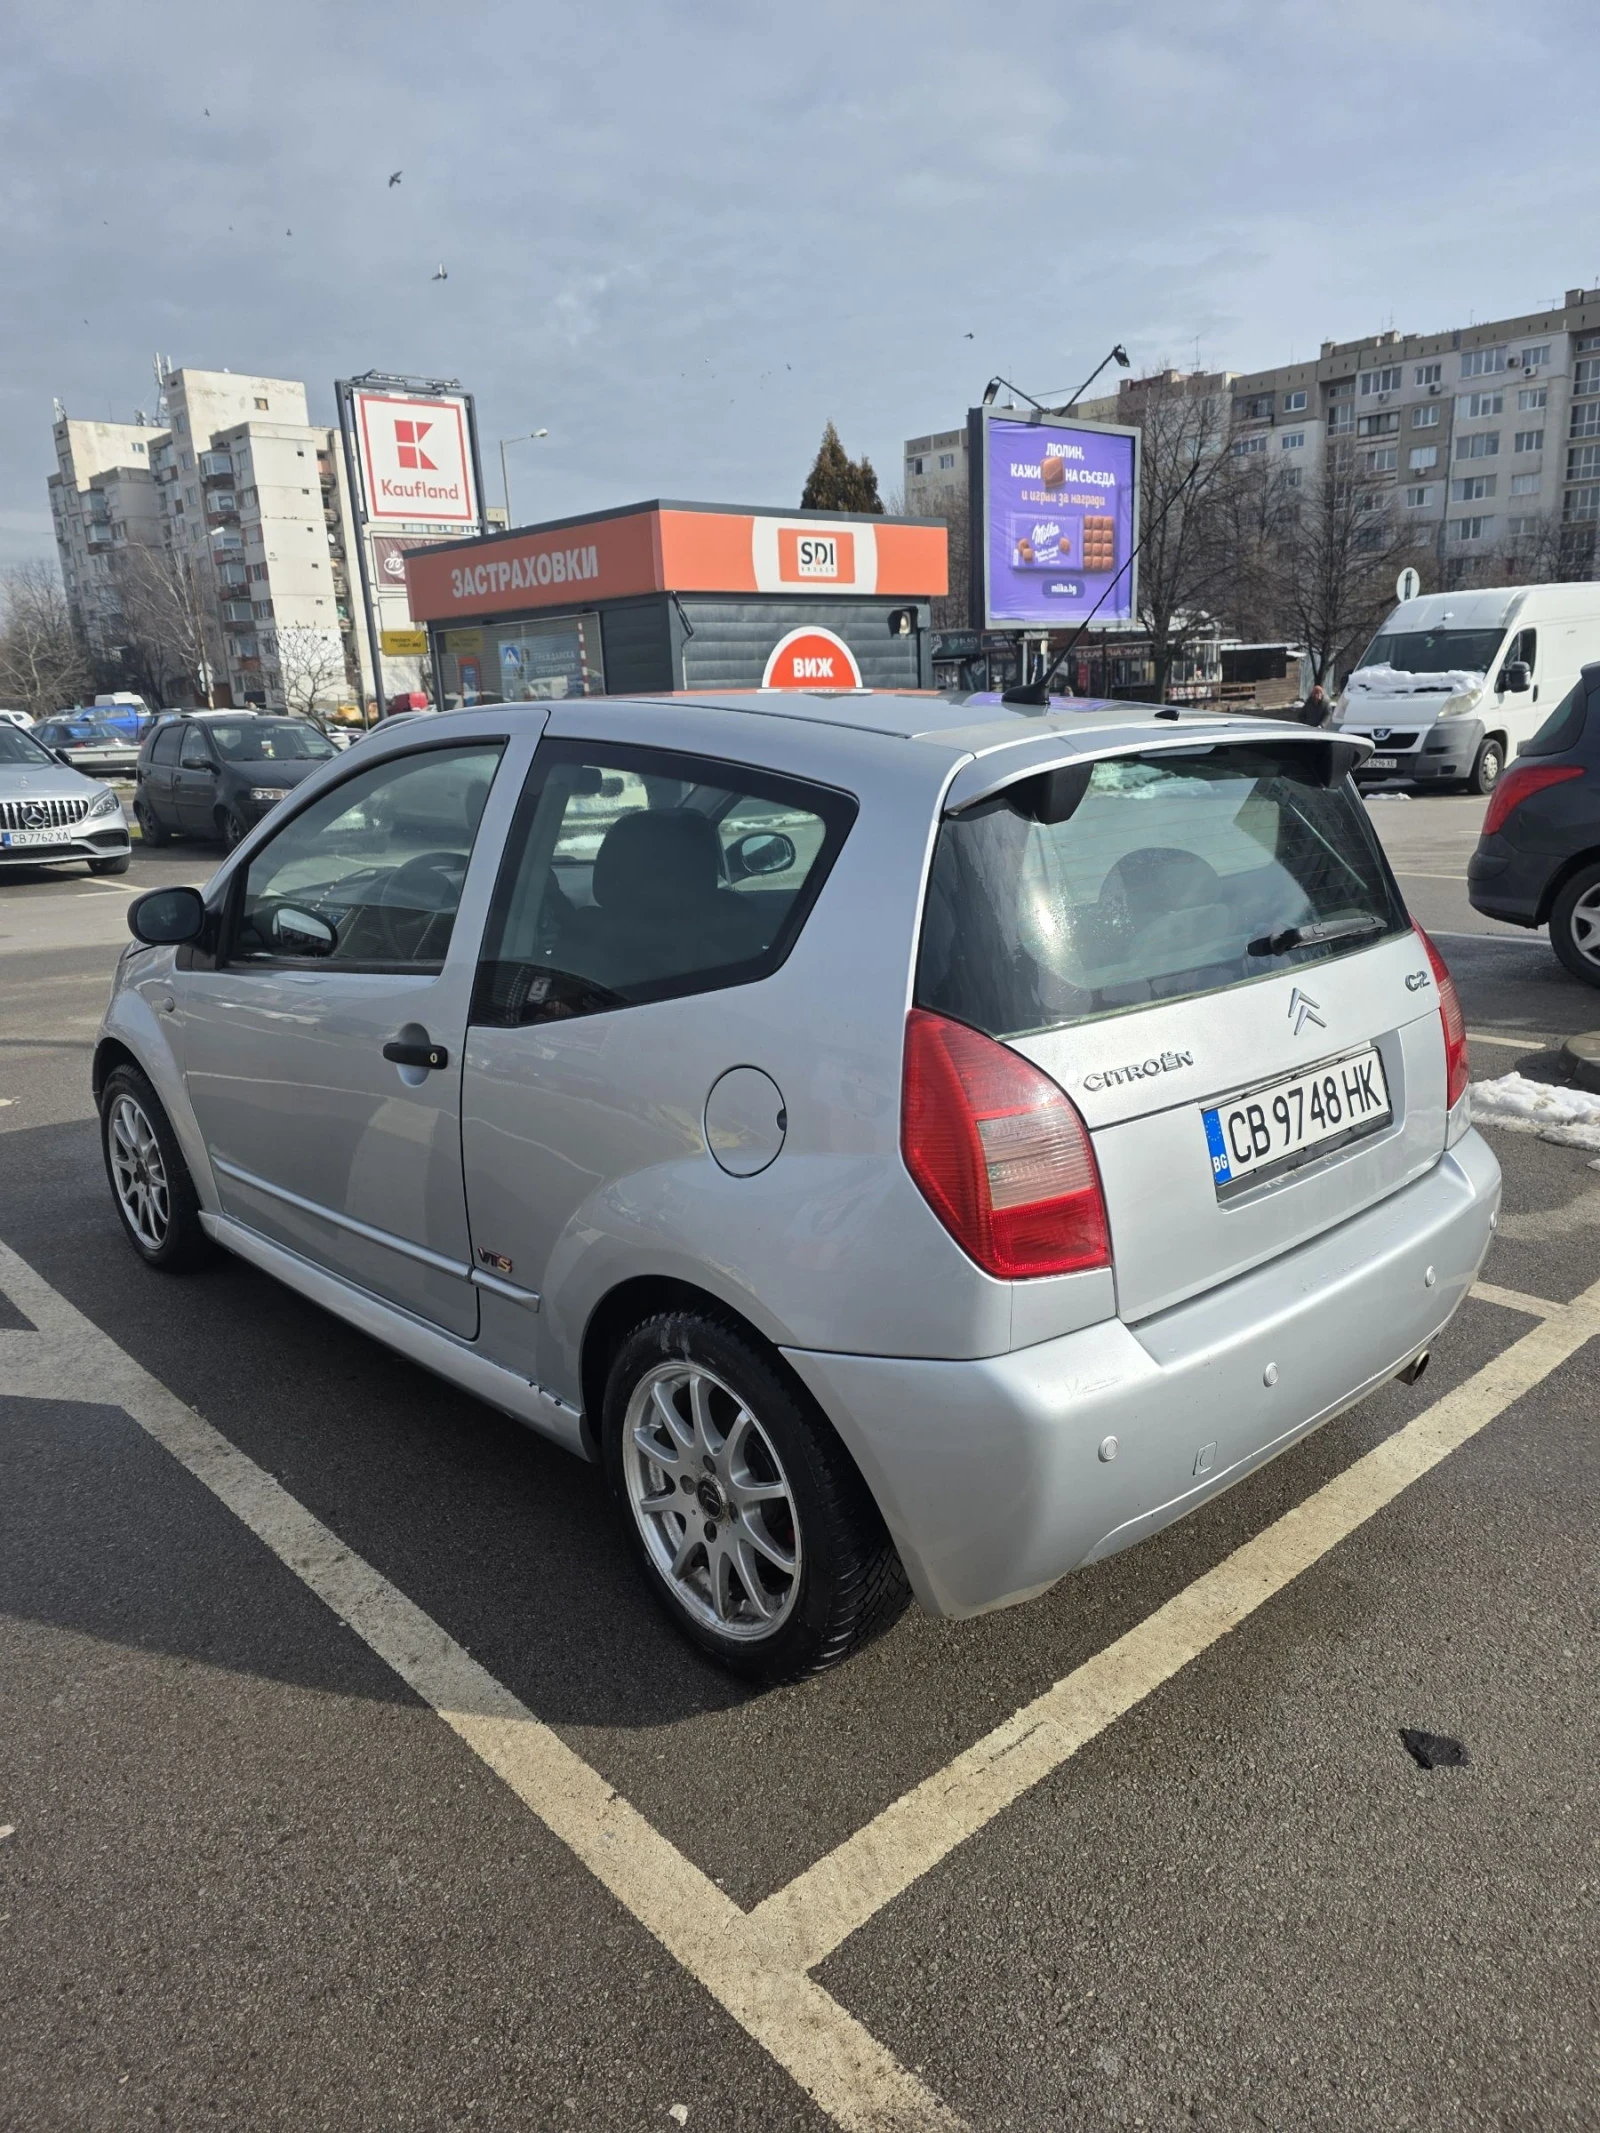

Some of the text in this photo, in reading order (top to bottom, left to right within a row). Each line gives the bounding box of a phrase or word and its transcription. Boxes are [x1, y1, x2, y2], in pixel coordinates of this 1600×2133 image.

[1045, 442, 1085, 460] ЛЮЛИН,
[1010, 463, 1116, 488] КАЖИ НА СЪСЕДА
[381, 479, 459, 499] Kaufland
[1021, 490, 1028, 500] и
[1058, 492, 1069, 507] за
[1070, 493, 1106, 509] награди
[1032, 521, 1060, 545] Milka
[801, 541, 834, 566] SDI
[451, 545, 599, 598] ЗАСТРАХОВКИ
[1051, 583, 1077, 596] milka.bg
[792, 657, 834, 678] ВИЖ
[11, 834, 27, 844] CB
[28, 832, 54, 843] 7762
[55, 831, 69, 842] XA
[1405, 970, 1430, 992] C2
[1083, 1050, 1194, 1091] CITROËN
[1212, 1060, 1382, 1172] BG CB 9748 HK
